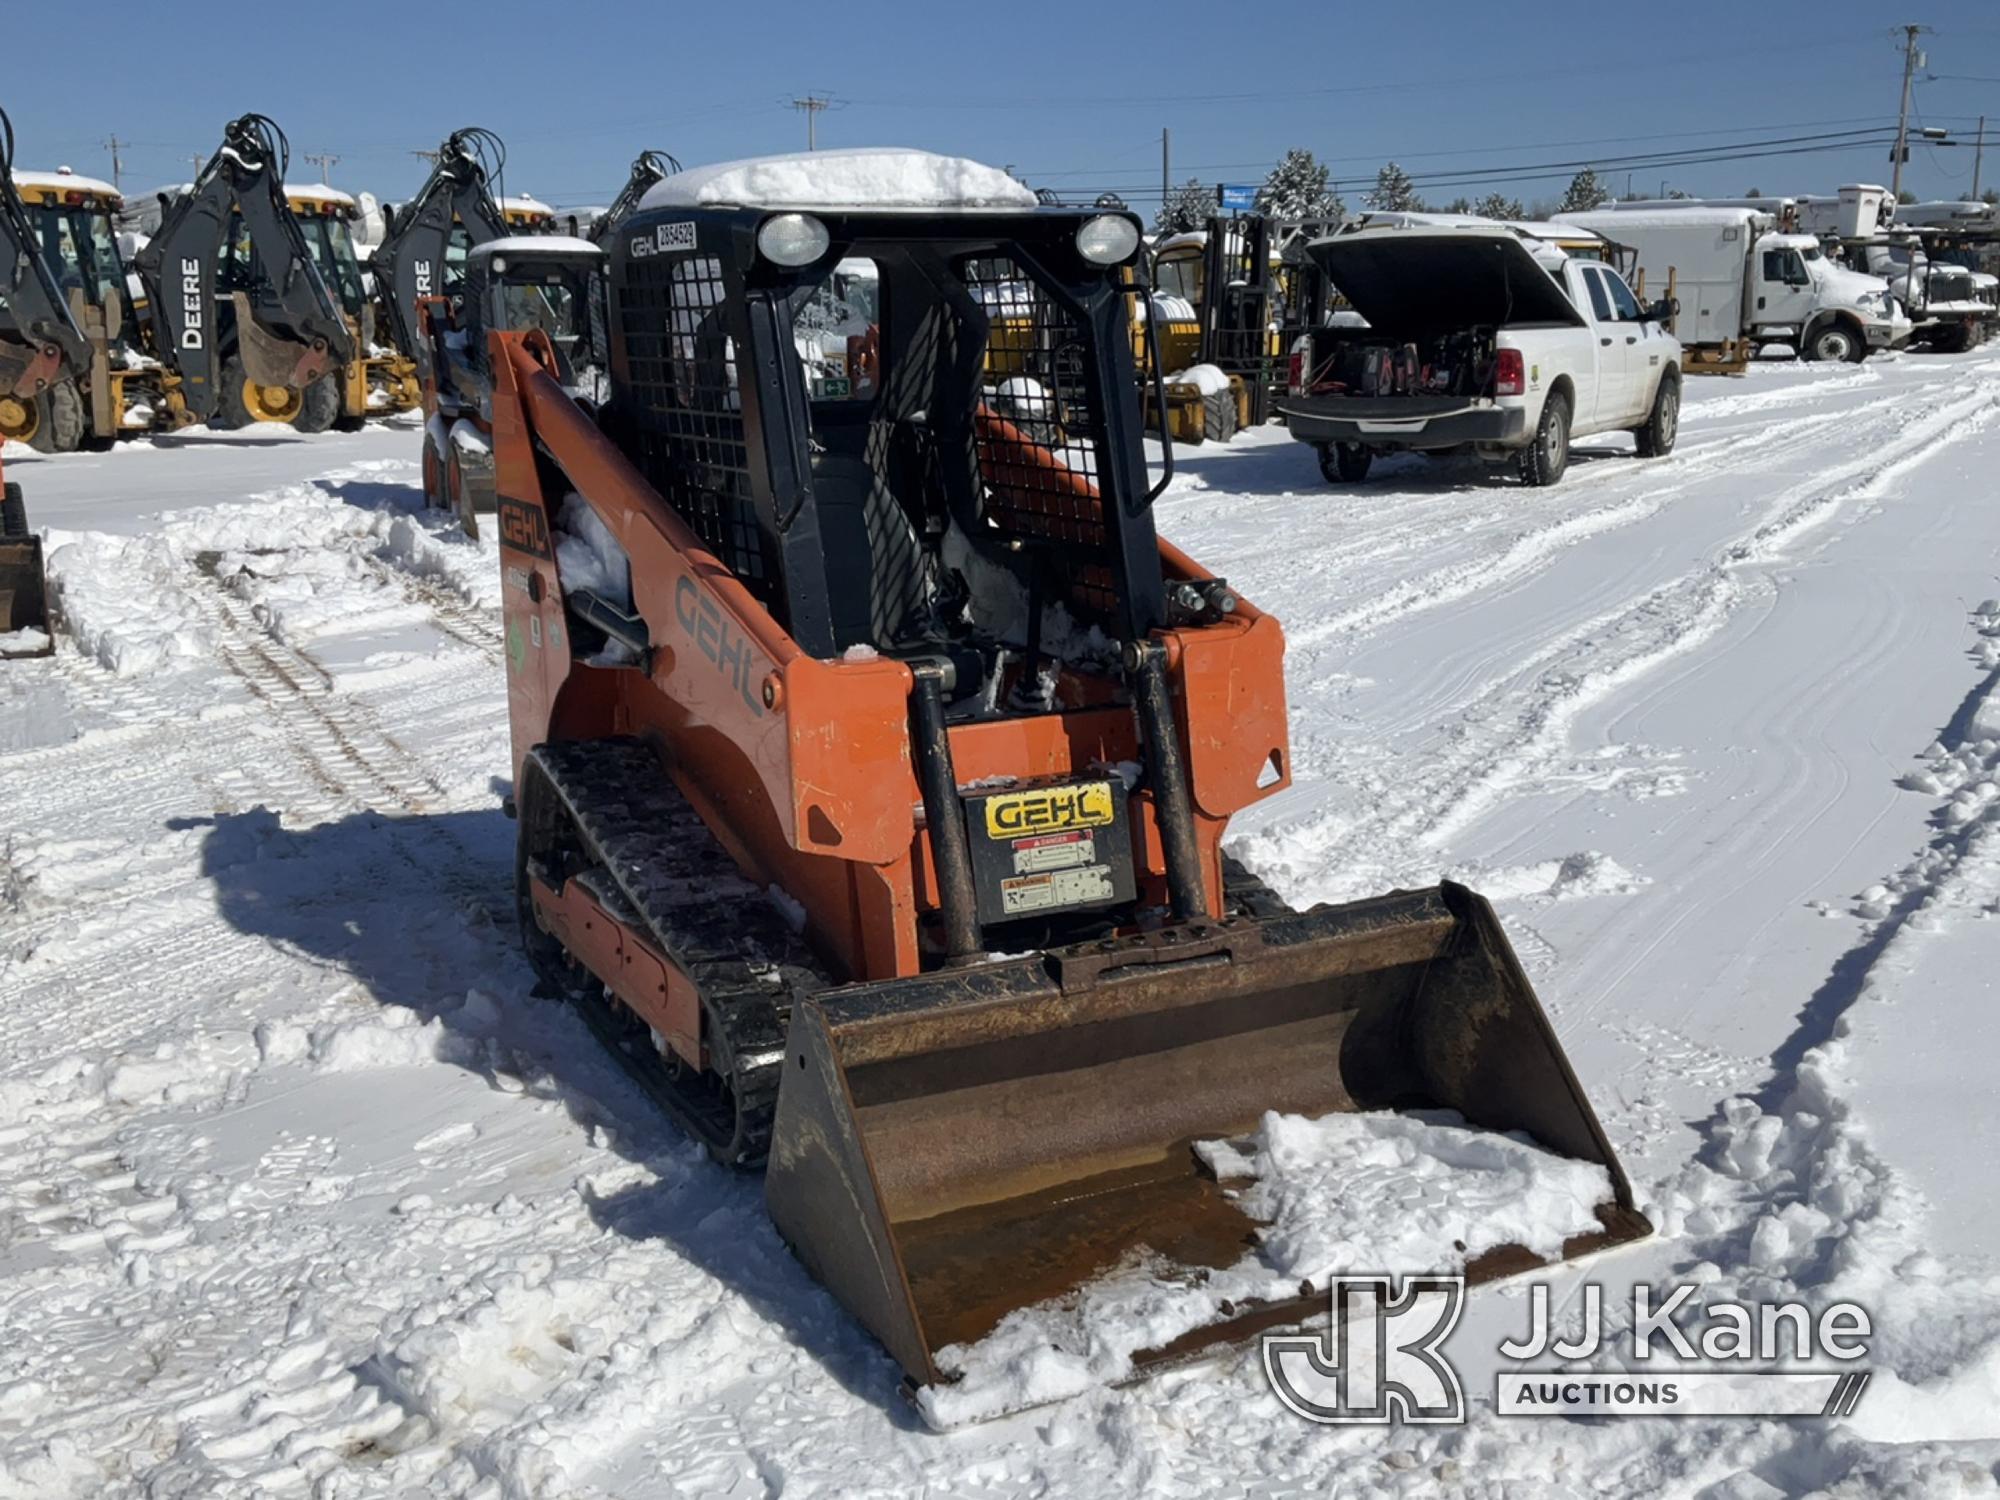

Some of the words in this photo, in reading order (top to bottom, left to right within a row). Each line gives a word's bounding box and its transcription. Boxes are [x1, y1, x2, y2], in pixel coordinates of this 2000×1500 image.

[631, 236, 658, 258] GEHL
[182, 258, 203, 350] DEERE
[502, 504, 546, 552] GEHL
[675, 574, 763, 718] GEHL
[995, 790, 1104, 829] GEHL
